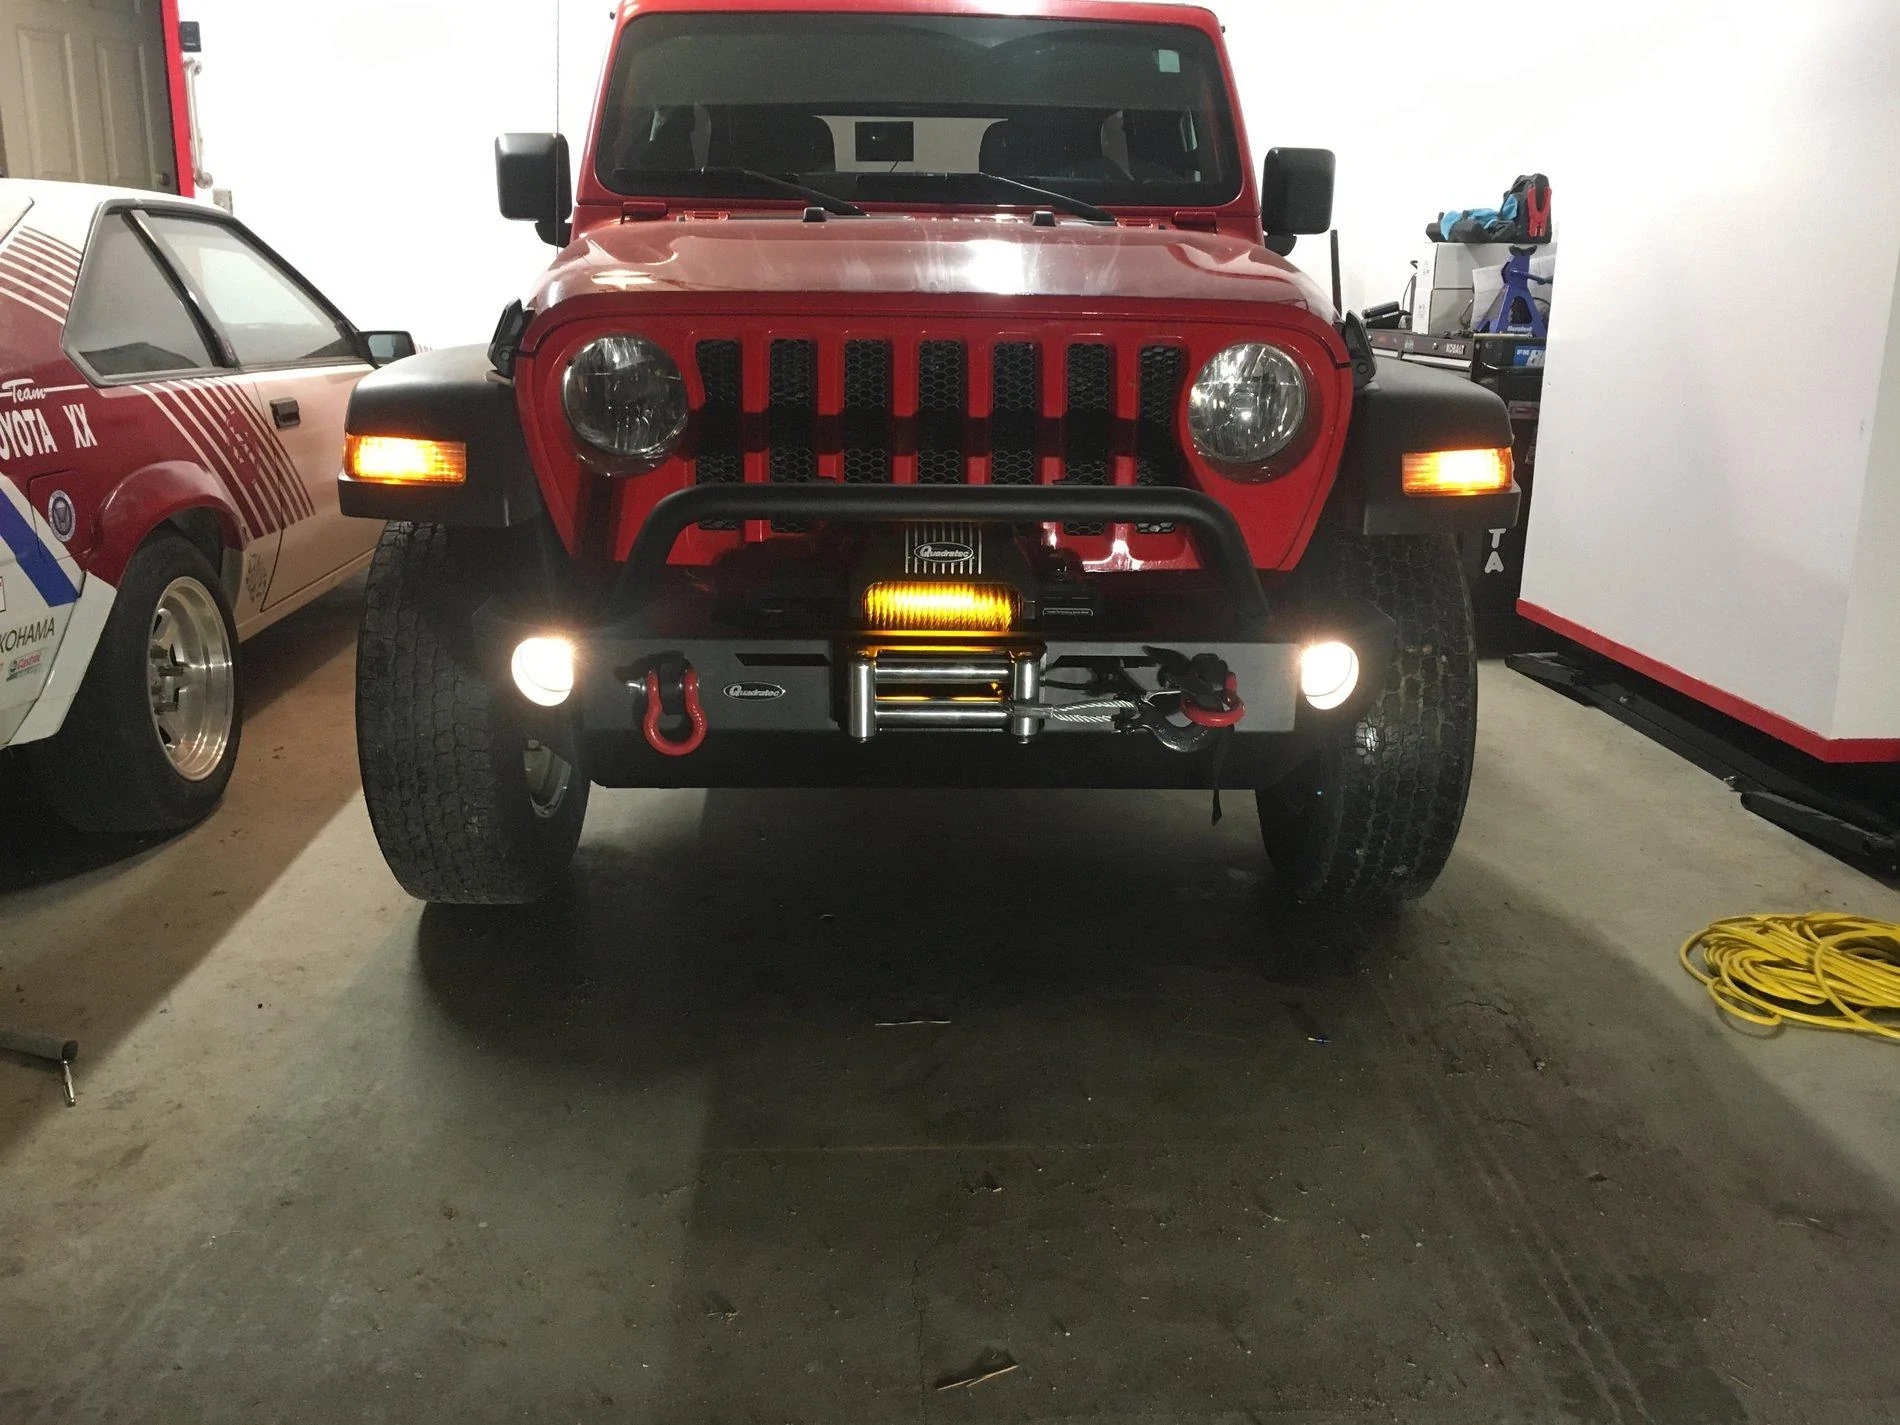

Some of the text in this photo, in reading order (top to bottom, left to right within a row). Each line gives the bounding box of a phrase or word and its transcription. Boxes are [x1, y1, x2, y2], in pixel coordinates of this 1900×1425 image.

[1, 378, 46, 403] Team
[62, 403, 98, 449] XX
[919, 545, 969, 558] Quadratec
